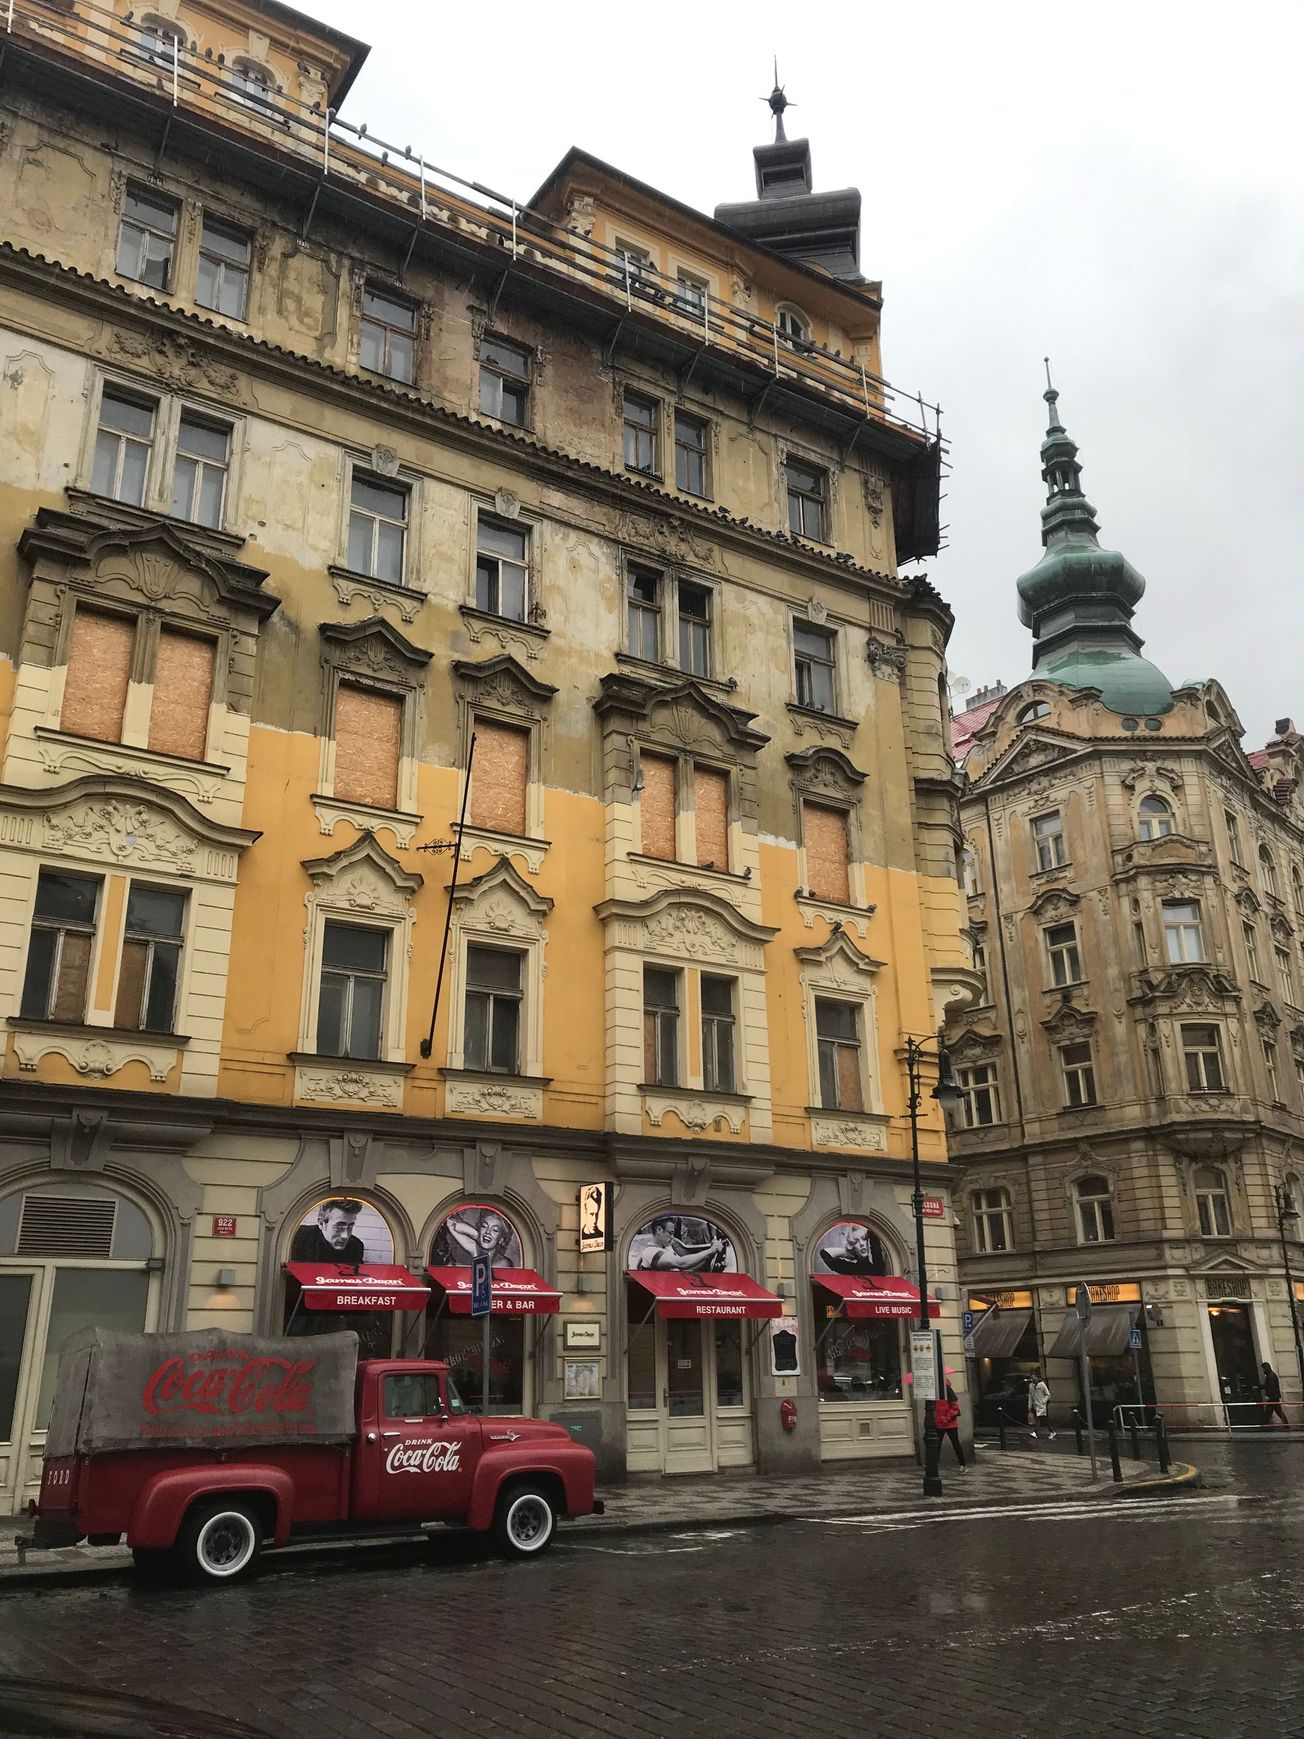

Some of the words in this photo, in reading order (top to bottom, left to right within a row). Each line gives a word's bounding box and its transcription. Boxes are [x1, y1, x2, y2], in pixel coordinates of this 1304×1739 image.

[217, 1218, 233, 1227] 922
[476, 1263, 486, 1296] P
[1207, 1279, 1248, 1297] BAKESHOP
[336, 1295, 397, 1306] BREAKFAST
[506, 1300, 513, 1309] &
[515, 1301, 535, 1309] BAR
[696, 1305, 747, 1315] RESTAURANT
[874, 1306, 890, 1314] LIVE
[891, 1306, 913, 1314] MUSIC
[143, 1356, 320, 1415] Coca-Cola
[404, 1438, 433, 1446] DRINK
[385, 1441, 462, 1475] Coca-Cola
[47, 1469, 70, 1485] FORD
